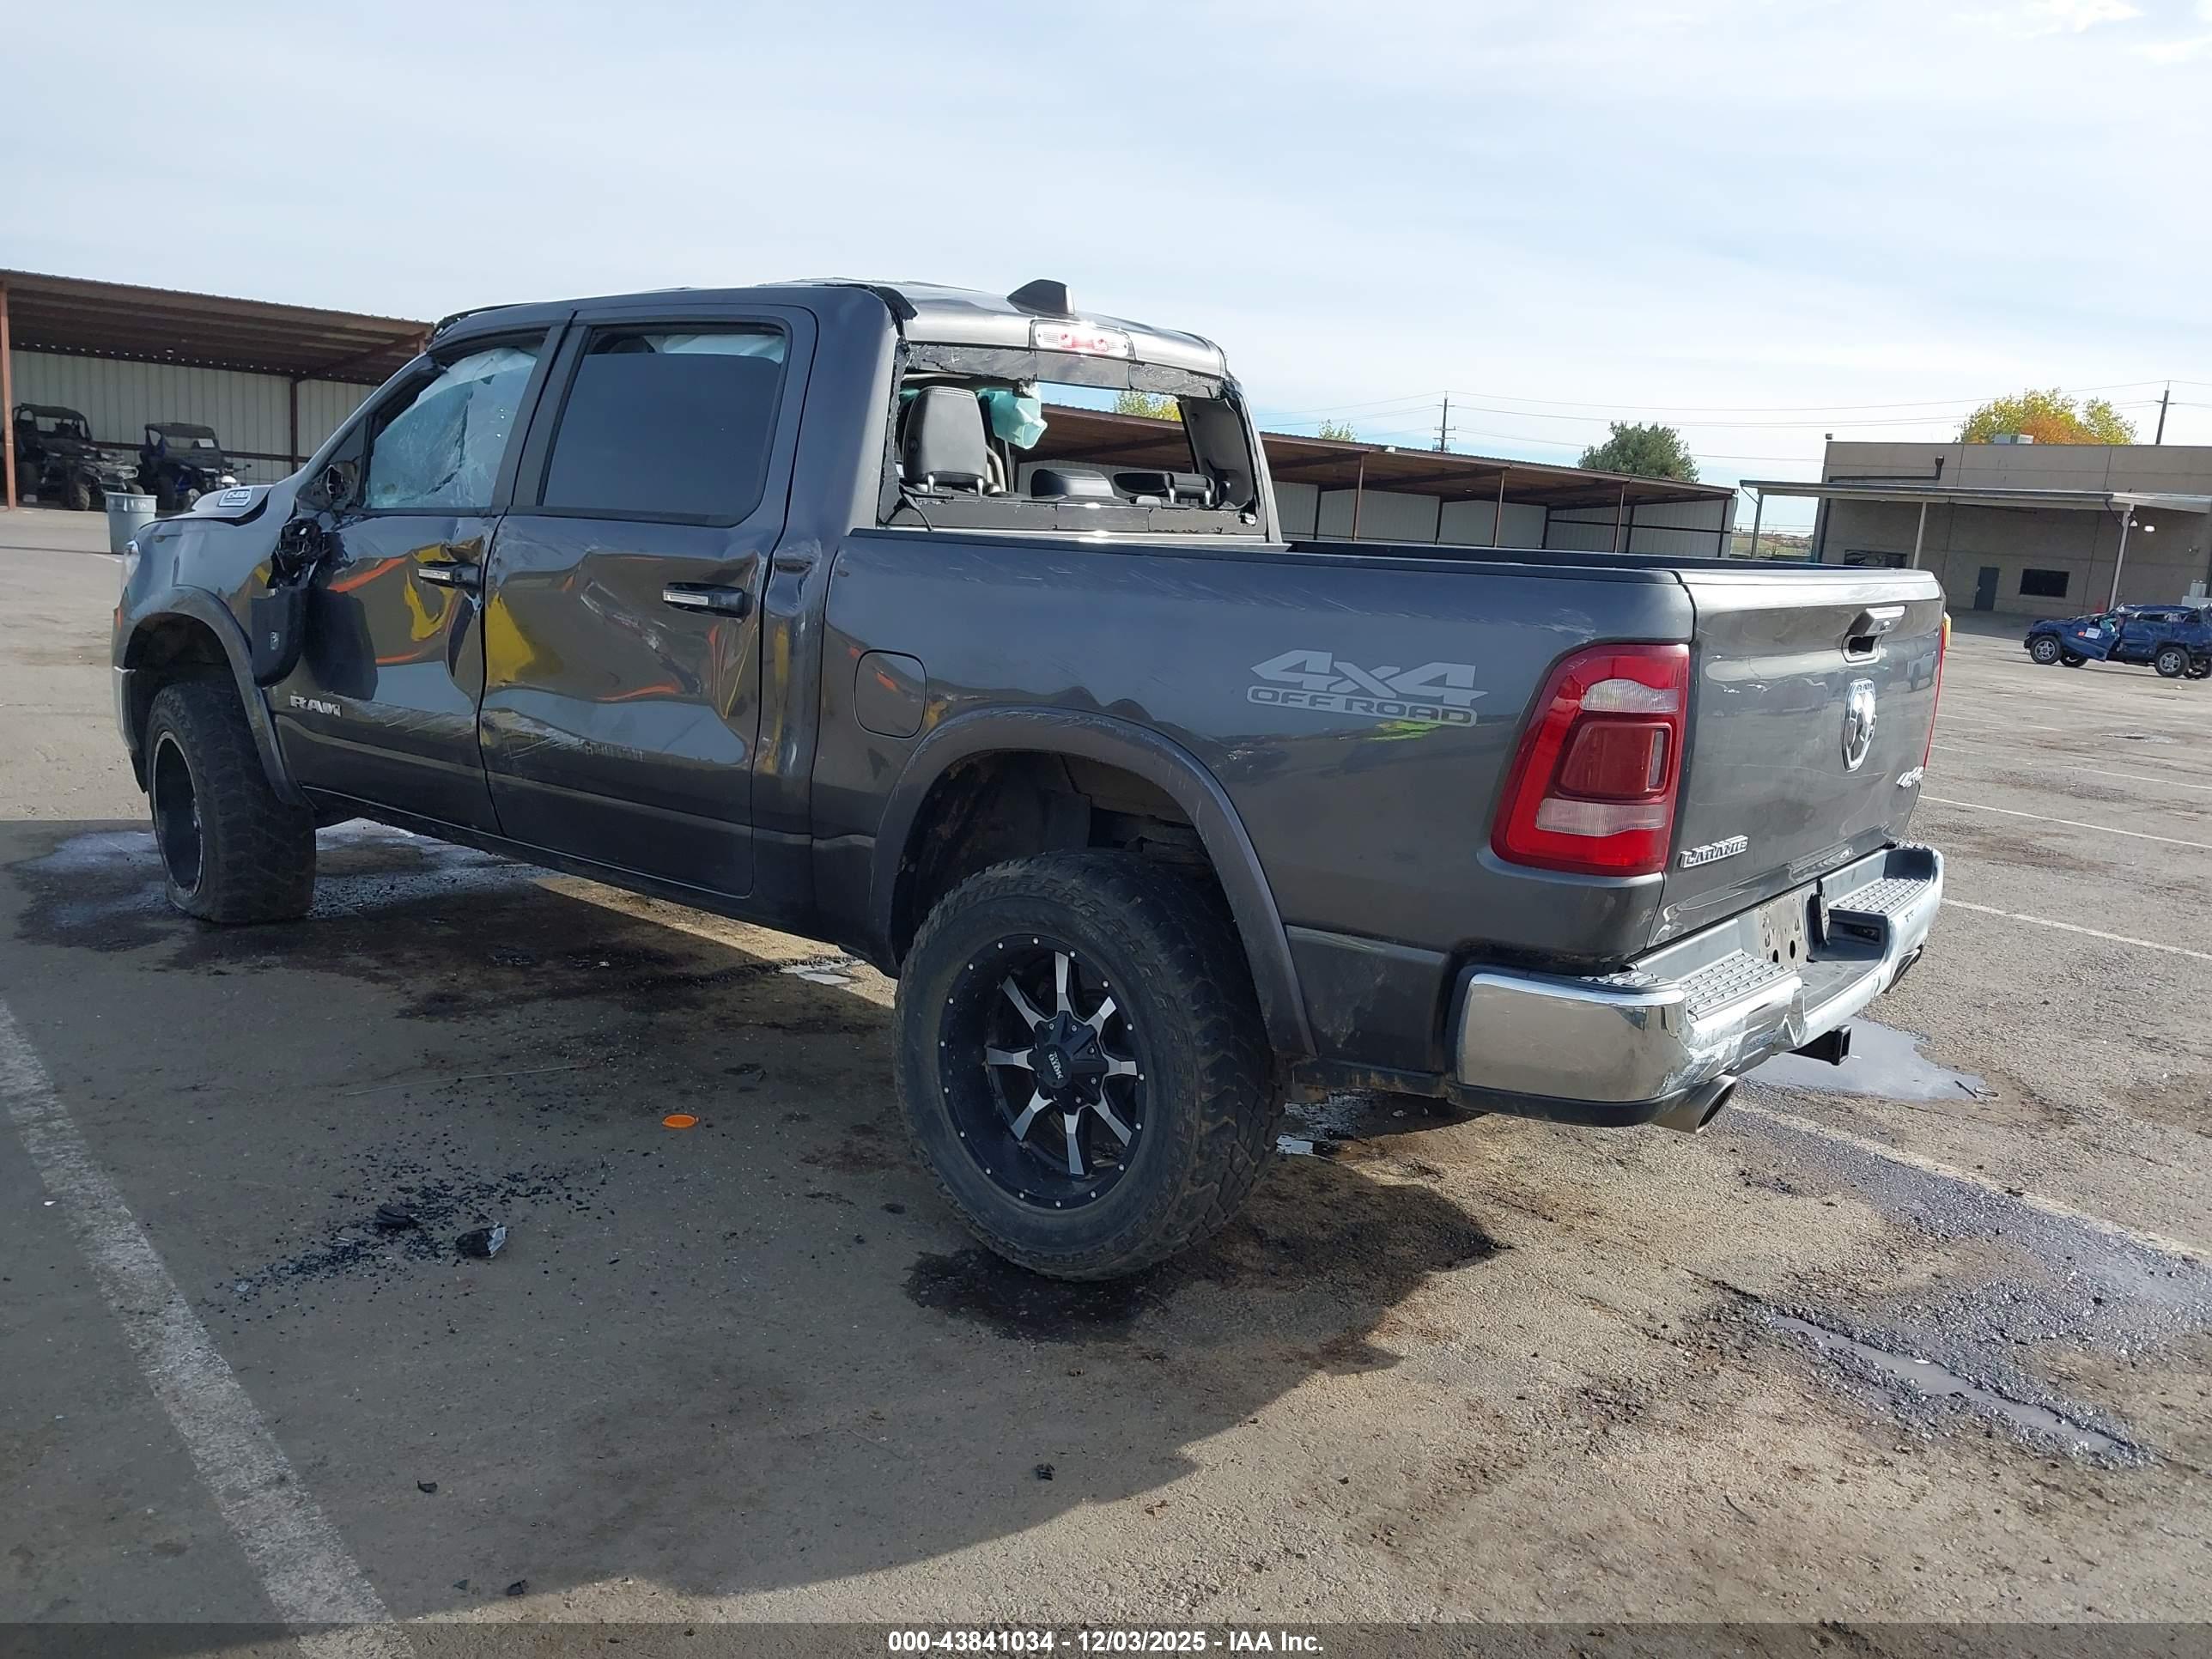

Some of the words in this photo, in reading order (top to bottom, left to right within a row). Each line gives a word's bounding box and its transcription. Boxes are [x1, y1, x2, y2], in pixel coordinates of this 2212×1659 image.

[289, 695, 342, 717] RAM
[1250, 688, 1335, 708] OFF
[1344, 696, 1472, 725] ROAD
[1679, 835, 1749, 868] LARAMIE
